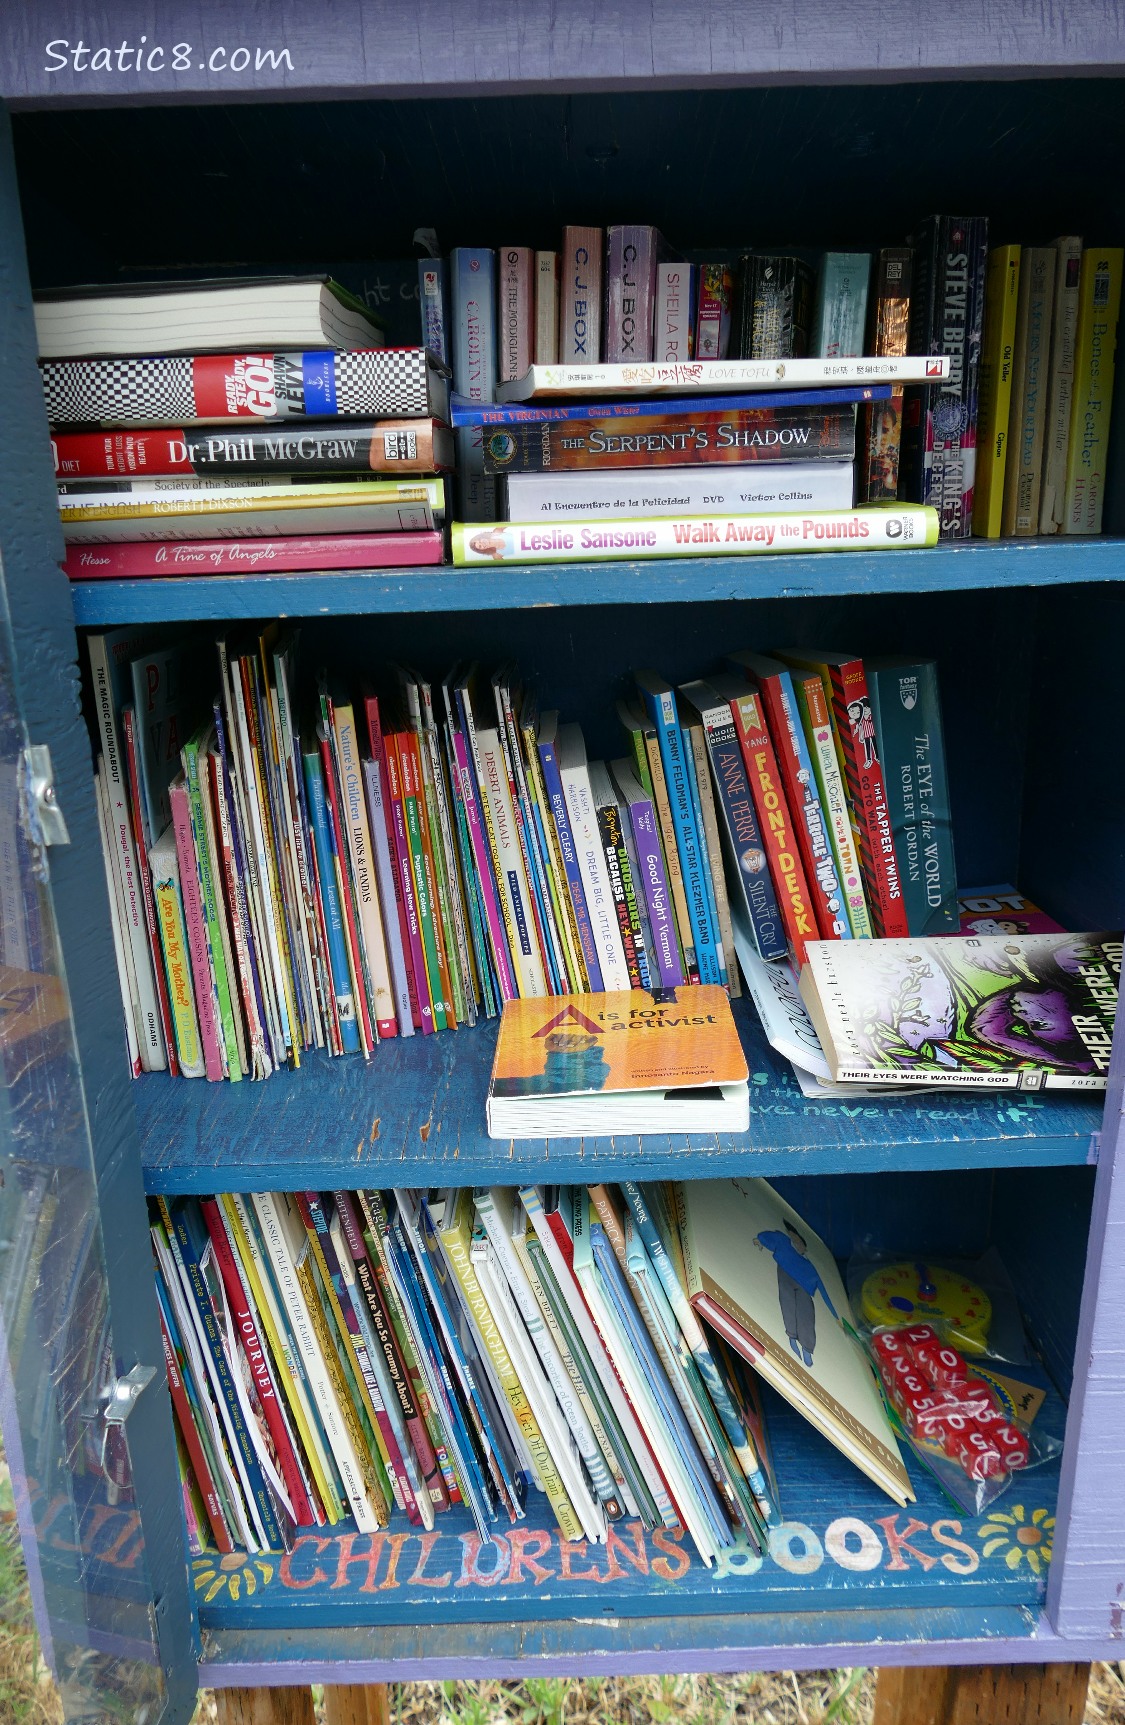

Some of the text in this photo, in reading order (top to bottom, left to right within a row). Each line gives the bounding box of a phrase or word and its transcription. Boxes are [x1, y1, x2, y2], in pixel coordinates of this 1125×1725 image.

[622, 299, 635, 353] BOX
[666, 273, 679, 335] SHEILA
[941, 253, 968, 397] STEVE BERRY
[467, 300, 482, 382] CAROLYN
[509, 308, 519, 372] MODIGLIANI
[574, 300, 587, 355] BOX
[244, 356, 278, 417] GO!
[274, 356, 287, 400] SHAWN
[286, 360, 306, 415] LEVY
[1081, 322, 1107, 467] Bones Feather
[481, 408, 570, 423] THE VIRGINIAN
[588, 406, 612, 417] Owen
[138, 439, 147, 465] REALITY
[262, 436, 359, 461] McGraw
[385, 432, 398, 459] bird
[541, 422, 550, 466] RIORDAN
[561, 438, 585, 449] THE
[589, 428, 708, 454] SERPENT'S
[716, 424, 811, 449] SHADOW
[61, 460, 81, 473] DIET
[154, 478, 270, 491] Society Spectacle
[930, 441, 945, 518] DECEPTI
[153, 501, 198, 513] ROBERT
[209, 499, 253, 510] DIXSON
[555, 496, 691, 510] Encuentro Felicidad
[703, 495, 725, 504] DVD
[740, 491, 813, 501] Victor Collins
[942, 460, 964, 530] KING'S
[1073, 479, 1086, 523] HAINES
[170, 544, 278, 564] Time of Angels
[520, 528, 657, 551] Leslie Sansone
[672, 518, 870, 547] Walk Away the Pounds
[81, 552, 111, 565] Hesse
[899, 676, 917, 685] TOR
[100, 690, 120, 784] MAGIC ROUNDABOUT
[710, 732, 737, 744] BOOKS
[744, 735, 768, 749] YANG
[339, 725, 361, 821] Nature's Children
[371, 774, 382, 807] ILLNESS
[484, 751, 511, 850] DESERT ANIMALS
[568, 783, 582, 822] HARRISON
[719, 753, 758, 843] ANNE PERRY
[914, 733, 943, 908] The EYE of the WORLD
[552, 794, 567, 829] BEVERLY
[561, 831, 575, 863] CLEARY
[603, 807, 618, 847] Boynton
[666, 729, 710, 945] BENNY FELDMAN'S KLEZMER BAND
[868, 810, 878, 832] WAR
[873, 782, 900, 900] THE TAPPER TWINS
[900, 764, 920, 882] ROBERT JORDAN
[352, 827, 372, 903] LIONS PANDAS
[755, 752, 787, 849] FRONT
[779, 854, 812, 936] DESK
[803, 799, 827, 860] TERRIBLE
[817, 855, 838, 896] TWO
[606, 846, 624, 901] BECAUSE
[618, 848, 641, 930] DINOSAURS
[129, 888, 139, 927] Detective
[570, 881, 596, 965] DEAR HENSHAW
[586, 851, 617, 965] DREAM ONE
[646, 854, 674, 969] Good Night Vermont
[748, 880, 765, 922] SILENT
[161, 898, 189, 1007] Are You My Mother?
[623, 936, 637, 967] WHY
[759, 922, 778, 947] CRY
[147, 1012, 158, 1047] ODHAMS
[531, 1004, 669, 1039] A is for
[610, 1014, 718, 1031] activist
[1071, 1014, 1113, 1071] THEIR
[841, 1071, 1009, 1084] THEIR EYES WERE WATCHING GOD
[803, 1103, 979, 1121] never read
[596, 1200, 621, 1244] PATRICK
[261, 1203, 282, 1247] CLASSIC
[275, 1247, 288, 1274] TALE
[288, 1286, 302, 1318] PETER
[299, 1319, 316, 1357] RABBIT
[445, 1241, 515, 1378] JOHN BURNINGHAM
[541, 1299, 559, 1330] BRETT
[238, 1311, 275, 1399] JOURNEY
[357, 1263, 370, 1291] What
[366, 1293, 377, 1311] Are
[373, 1312, 385, 1329] You
[384, 1342, 401, 1380] Grumpy
[395, 1380, 414, 1415] About?
[543, 1352, 578, 1426] Uncorker Ocean
[562, 1351, 587, 1397] The Hat
[507, 1384, 561, 1497] Hey! Get Off Our Train
[834, 1405, 900, 1470] ALLEN SAY
[207, 1494, 219, 1516] SAVVAS
[556, 1502, 577, 1536] Crown
[278, 1523, 691, 1592] CHILDRENS
